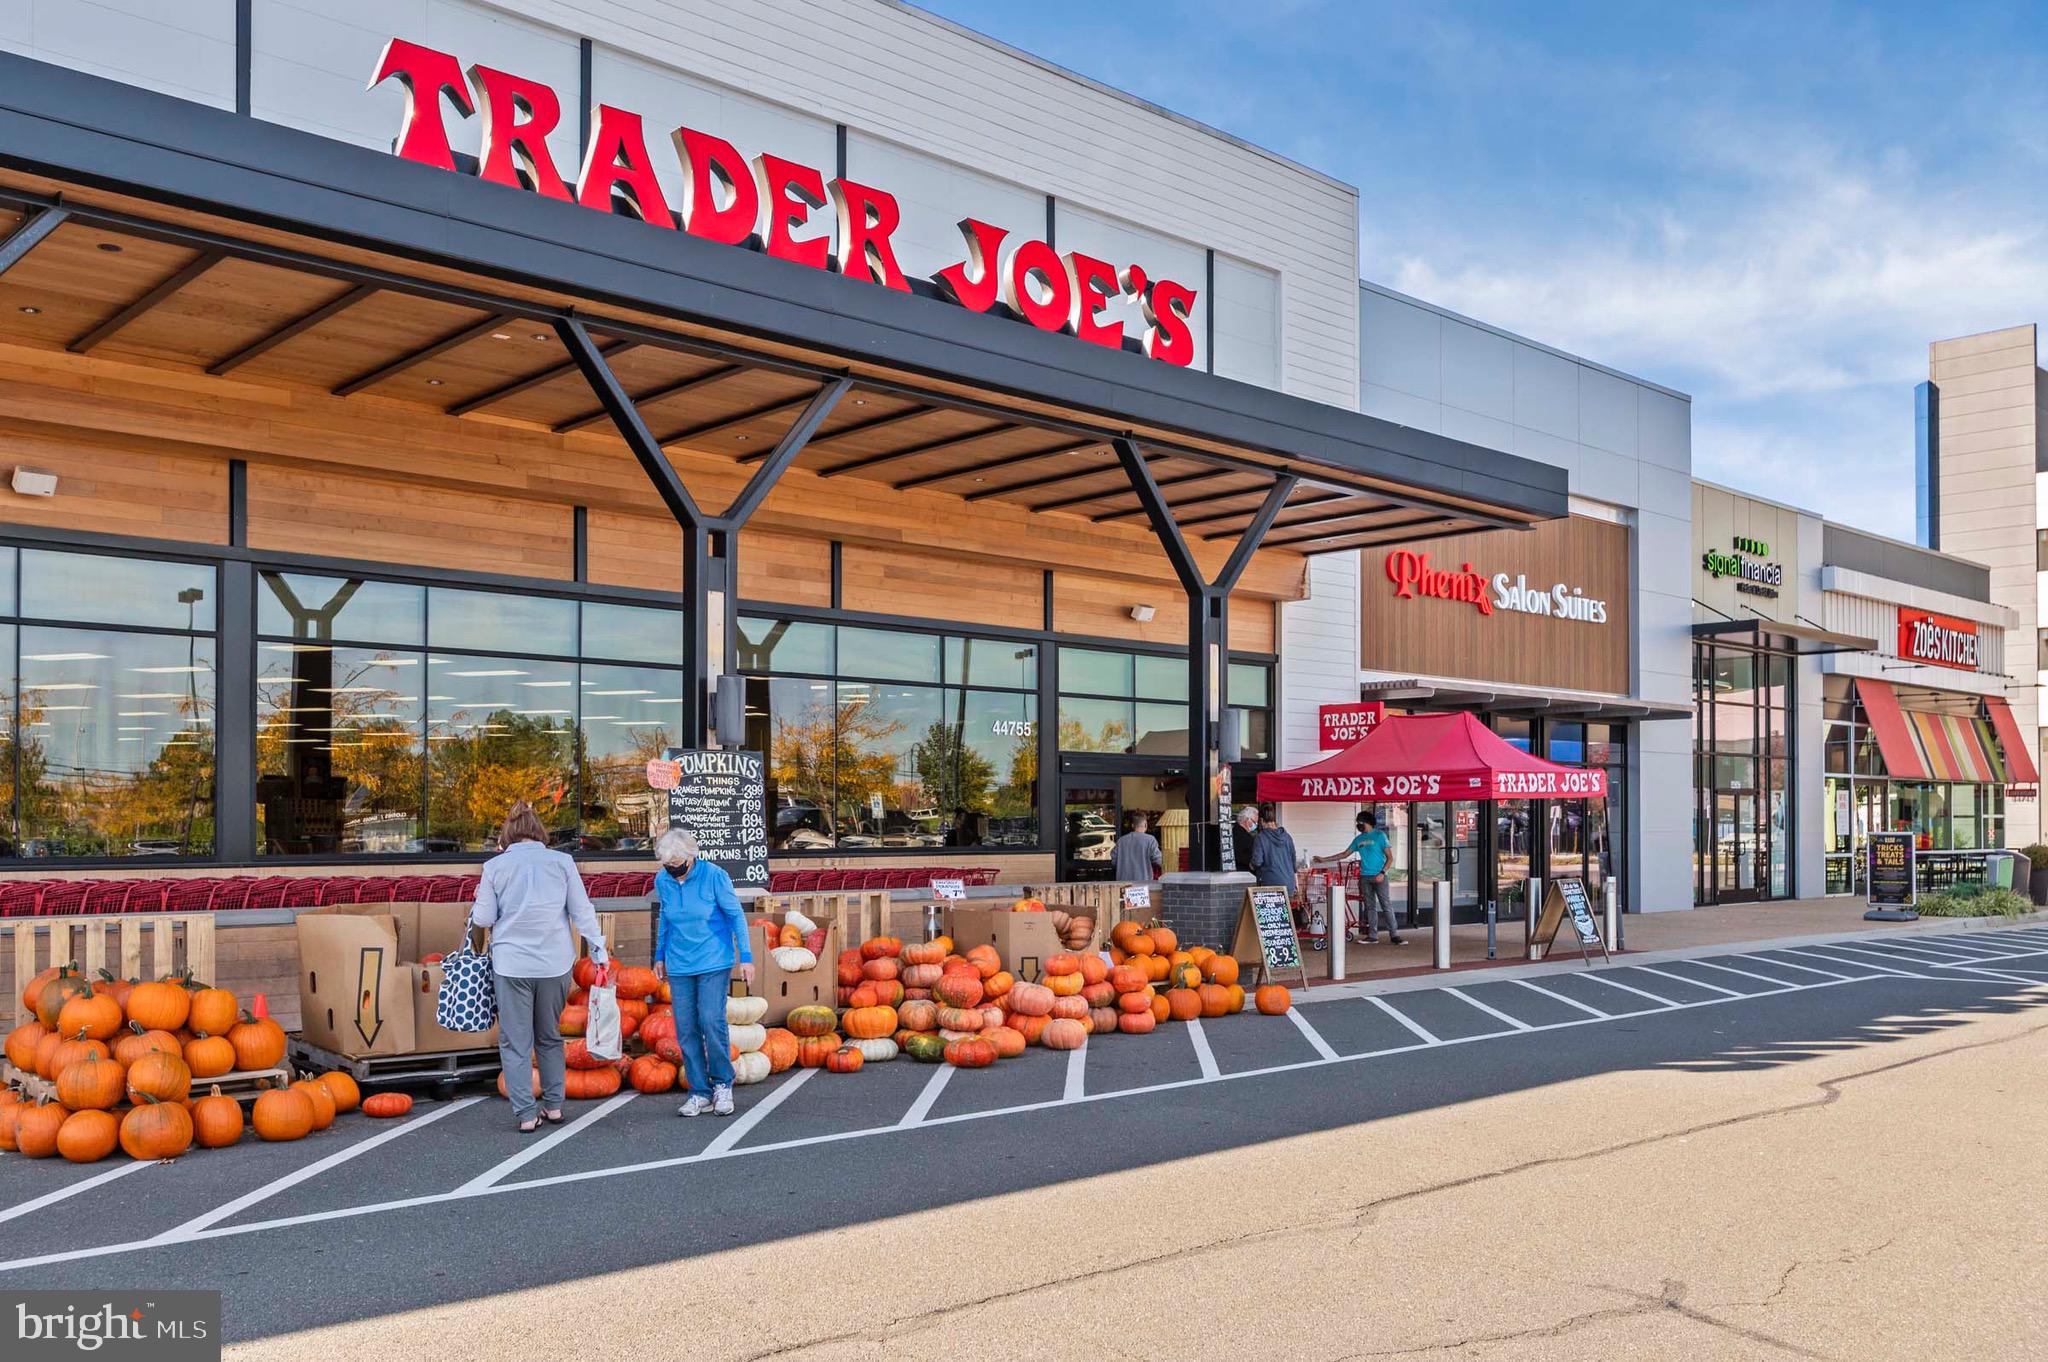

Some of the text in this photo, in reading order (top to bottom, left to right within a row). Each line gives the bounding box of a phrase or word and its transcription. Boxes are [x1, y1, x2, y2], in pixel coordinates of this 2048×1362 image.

[365, 37, 1197, 368] TRADER JOE'S
[1386, 549, 1493, 616] Phenix
[1941, 628, 1981, 667] KITCHEN
[1323, 711, 1376, 727] TRADER
[992, 720, 1031, 737] 44755
[1330, 726, 1369, 741] JOE'S
[706, 777, 740, 785] THINGS
[1301, 774, 1441, 796] TRADER JOE'S
[1497, 772, 1601, 793] TRADER JOE'S
[699, 829, 731, 839] STRIPE
[699, 848, 741, 861] UMPKINS
